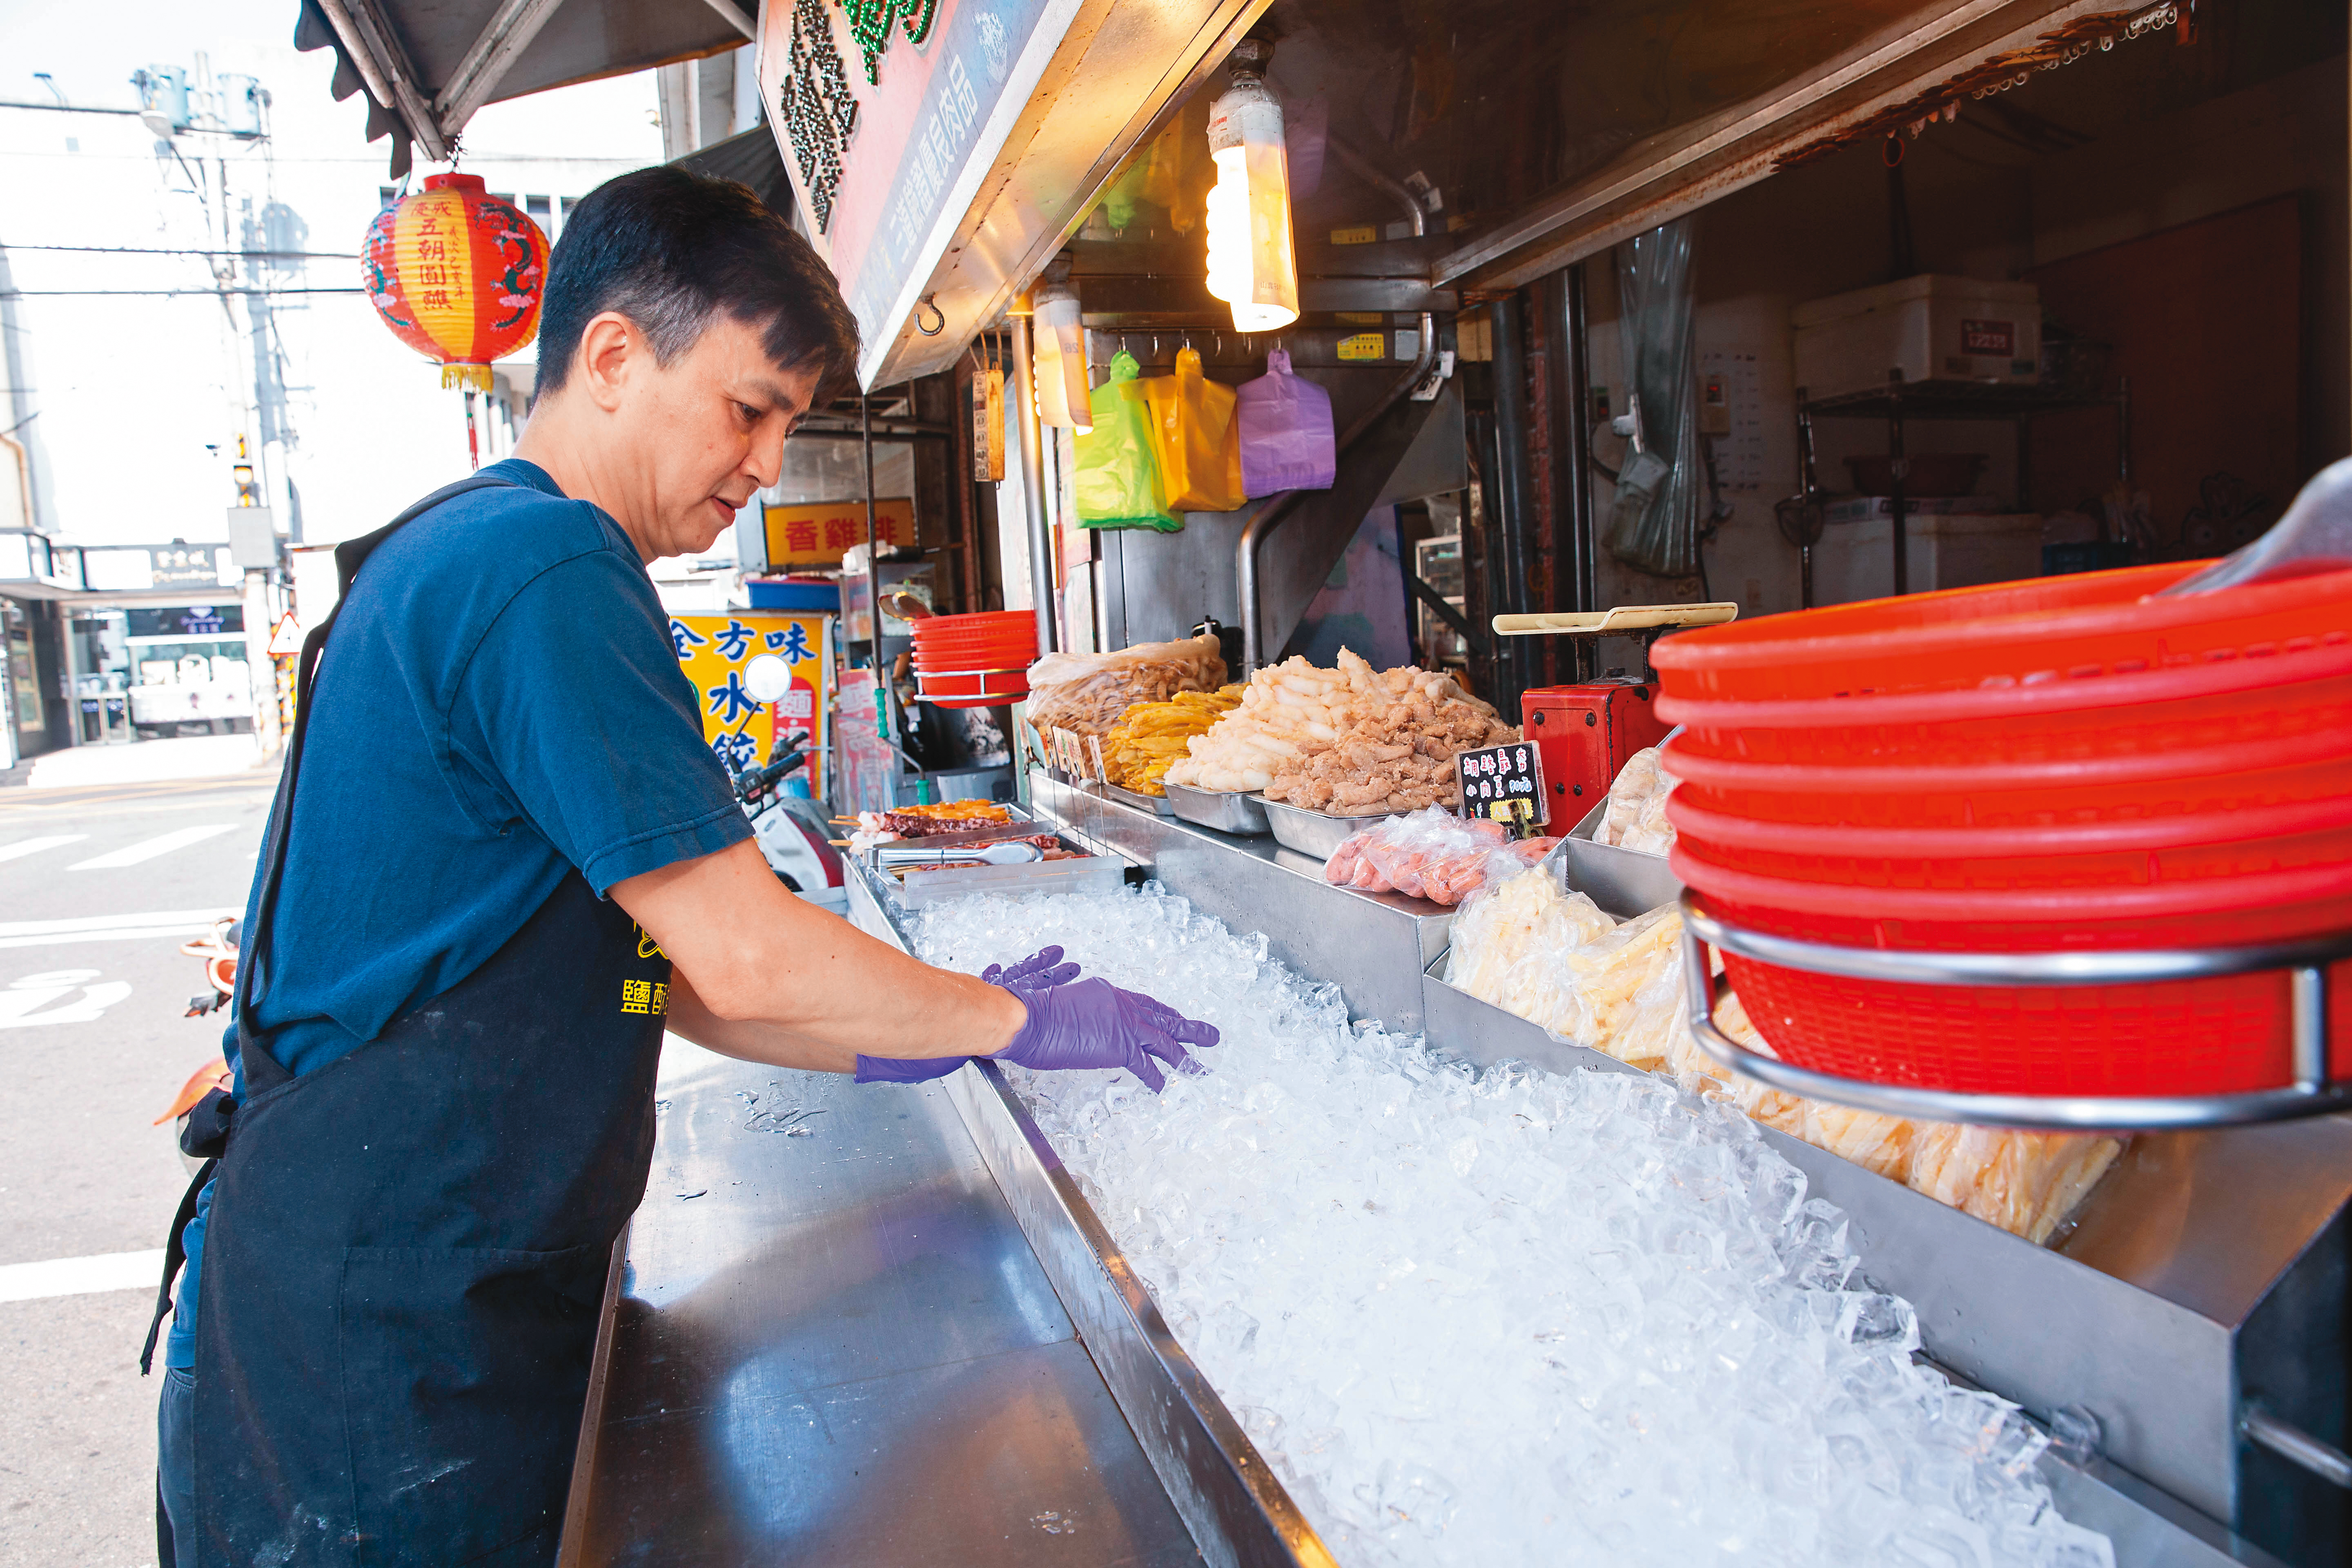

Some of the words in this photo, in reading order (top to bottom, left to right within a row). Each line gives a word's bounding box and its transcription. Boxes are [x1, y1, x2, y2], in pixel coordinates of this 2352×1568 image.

[785, 516, 898, 552] 香雞排
[671, 619, 817, 665] 全方味
